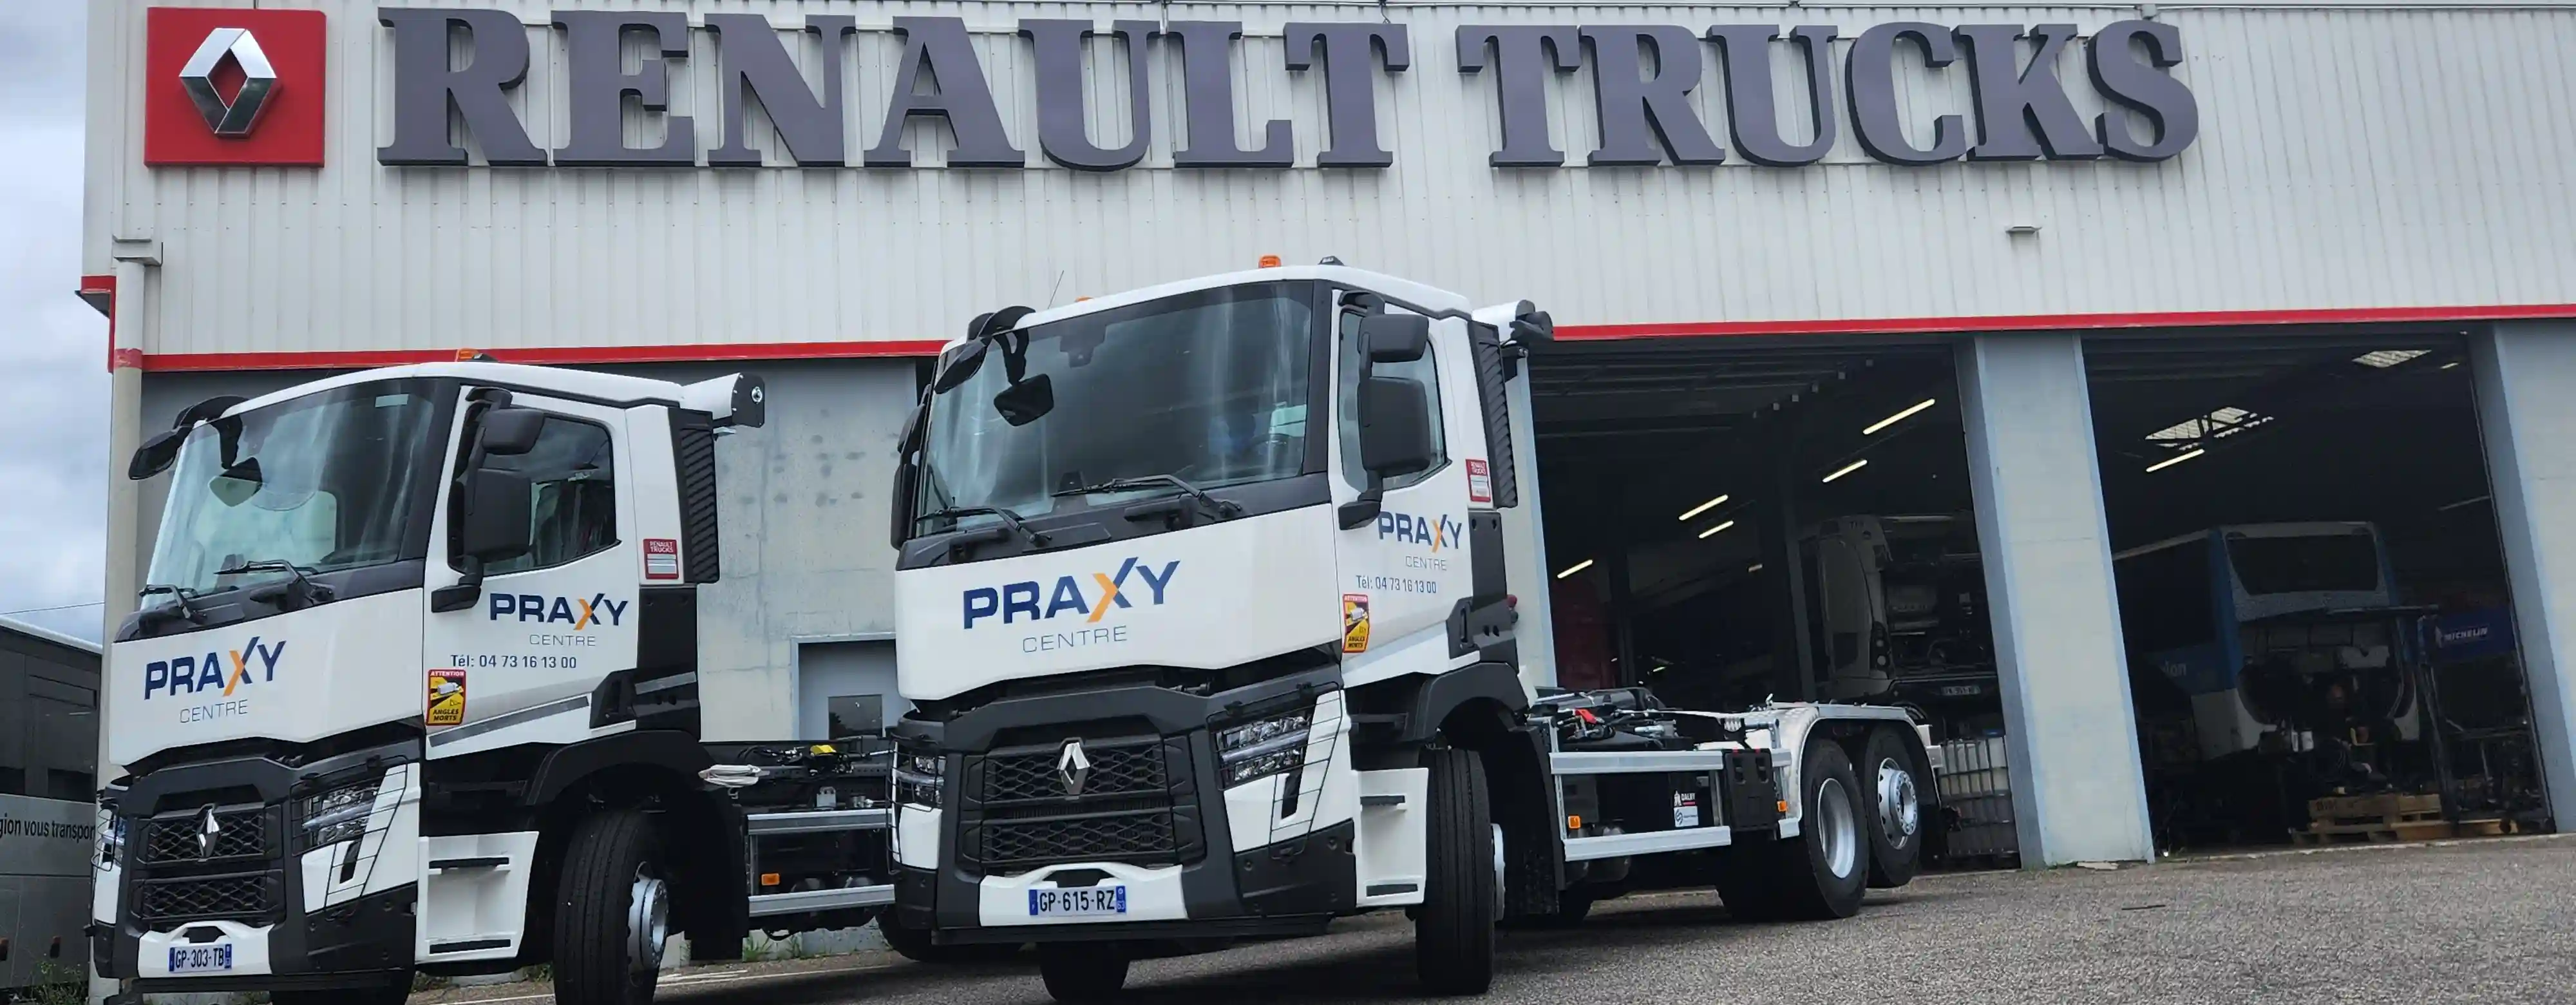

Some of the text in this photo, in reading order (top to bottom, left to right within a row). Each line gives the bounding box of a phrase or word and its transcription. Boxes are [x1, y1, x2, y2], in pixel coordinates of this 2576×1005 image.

[377, 7, 2199, 172] RENAULT TRUCKS
[1378, 511, 1463, 553] PRAXY
[1405, 555, 1448, 571] CENTRE
[963, 557, 1180, 629] PRAXY
[1356, 575, 1437, 594] Tél: 04 73 16 13 00
[490, 593, 629, 631] PRAXY
[529, 634, 596, 647] CENTRE
[1023, 626, 1128, 653] CENTRE
[2443, 627, 2488, 641] MICHELIN
[144, 636, 287, 700] PRAXY
[451, 654, 577, 669] Tél: 04 73 16 13 00
[180, 699, 249, 723] CENTRE
[24, 819, 50, 838] vous
[1039, 890, 1115, 912] GP-615-RZ
[175, 947, 225, 968] GP-303-TB
